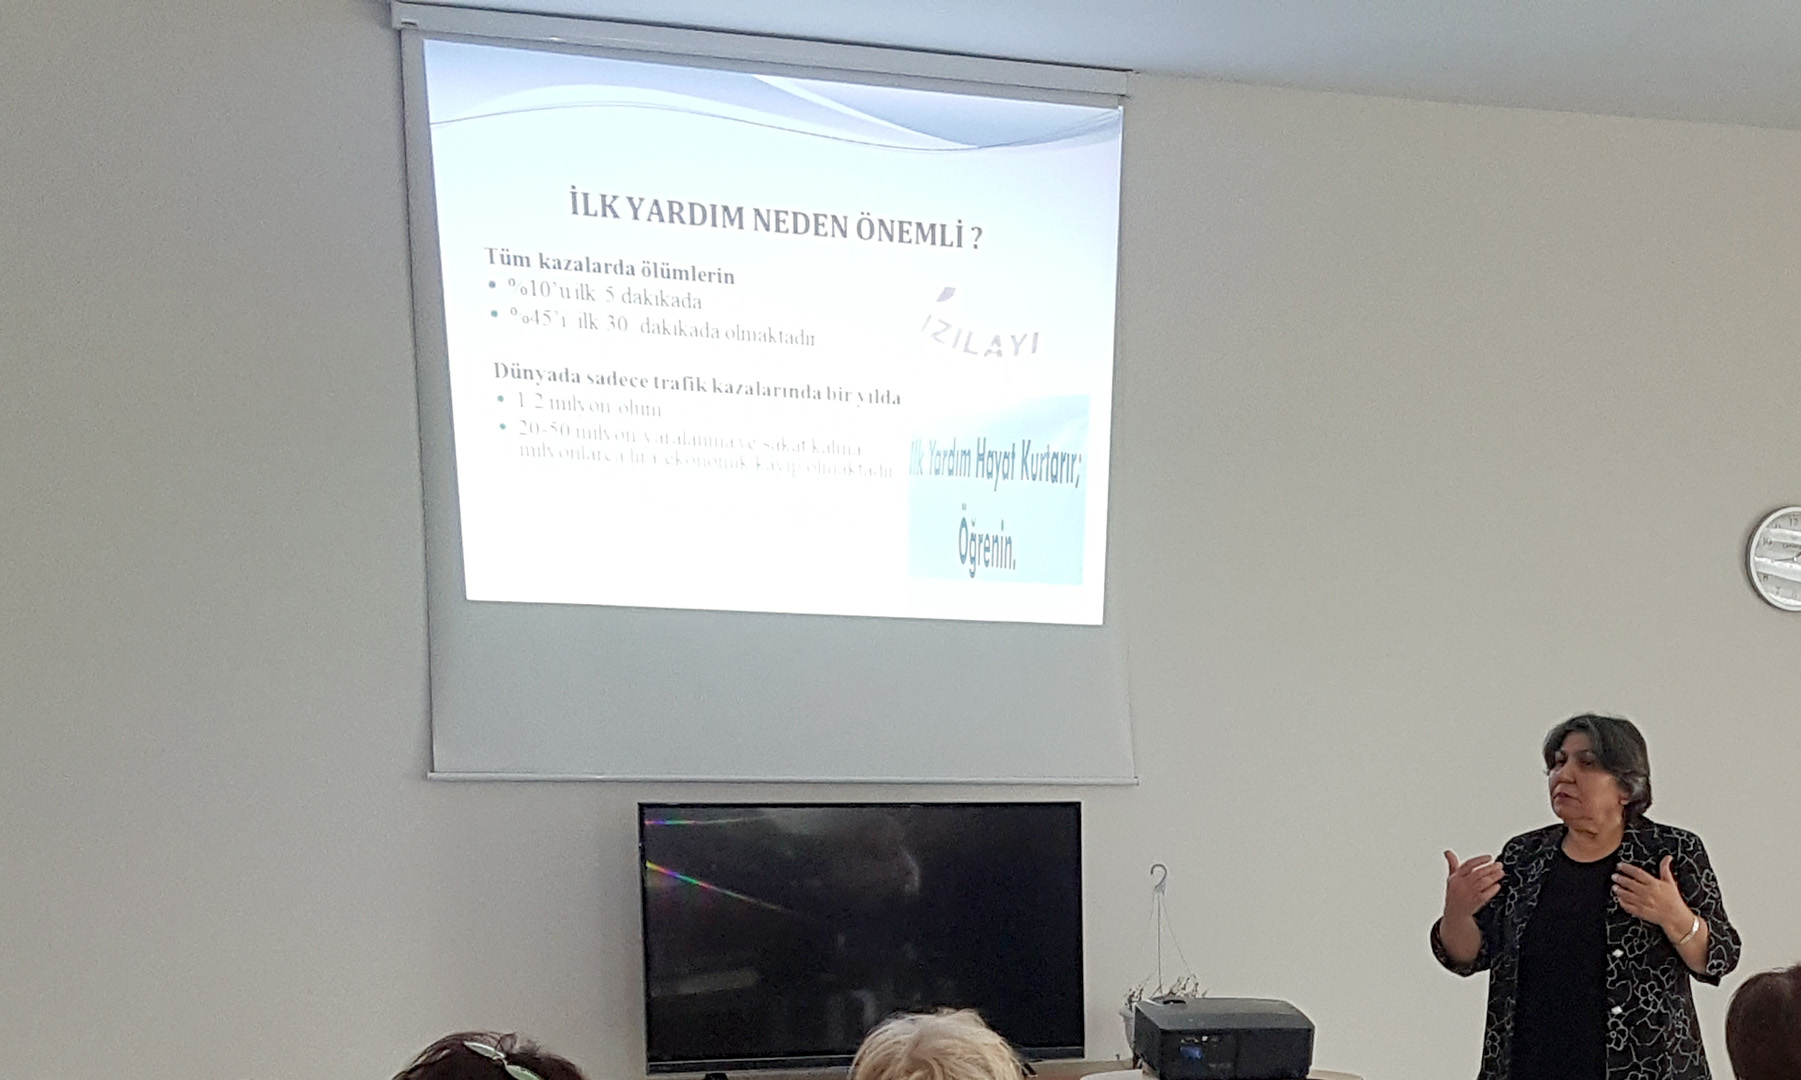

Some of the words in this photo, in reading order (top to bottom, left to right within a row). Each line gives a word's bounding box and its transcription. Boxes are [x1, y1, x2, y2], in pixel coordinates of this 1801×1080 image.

[569, 184, 621, 220] İLK
[625, 195, 745, 231] YARDIM
[752, 206, 849, 239] NEDEN
[855, 211, 964, 249] ÖNEMLİ
[970, 225, 984, 250] ?
[484, 246, 531, 269] Tüm
[538, 251, 636, 277] kazalarda
[641, 259, 736, 285] ölümlerin
[606, 313, 629, 332] 30
[493, 361, 581, 386] Dünyada
[586, 370, 649, 389] sadece
[653, 374, 708, 393] trafik
[711, 377, 822, 400] kazalarında
[826, 384, 853, 402] bir
[856, 388, 901, 408] yılda
[929, 436, 971, 478] Yardım
[975, 436, 1017, 492] Hayat
[958, 502, 1017, 579] Öğrenin.
